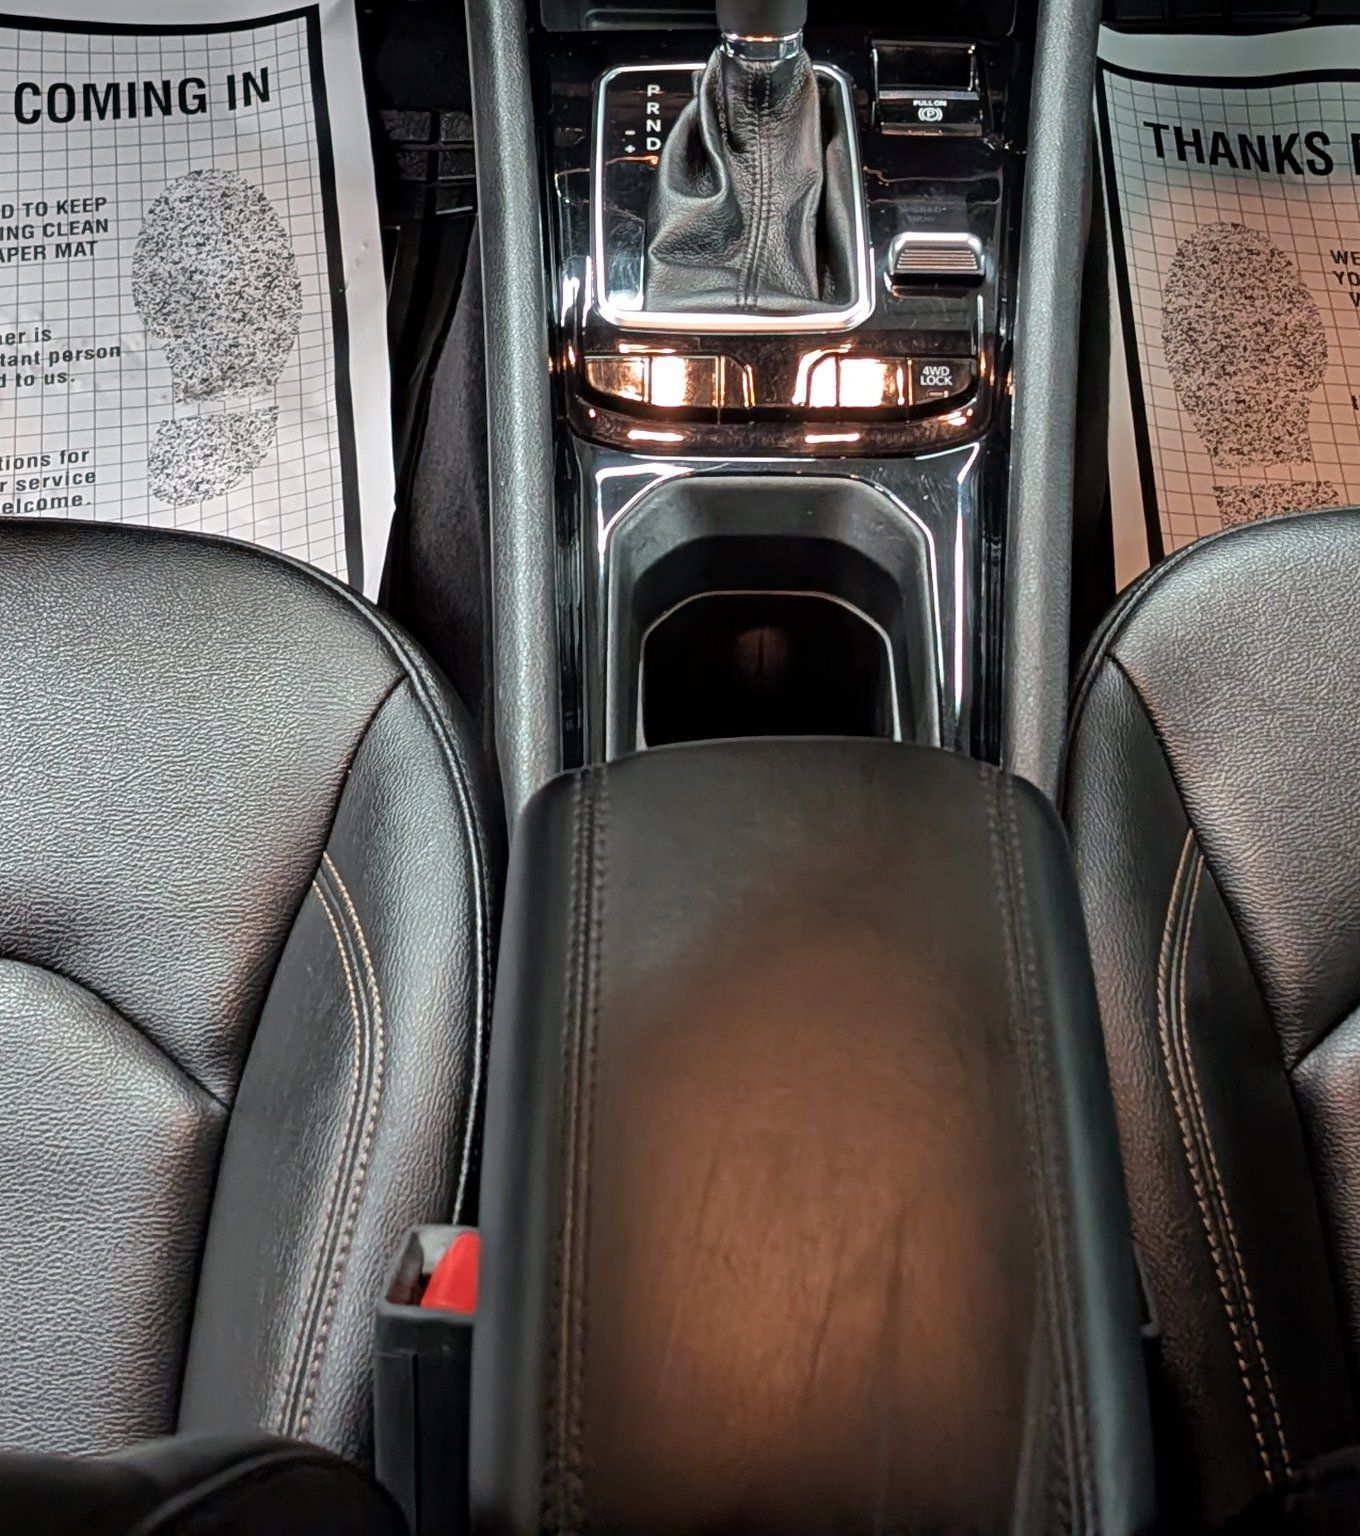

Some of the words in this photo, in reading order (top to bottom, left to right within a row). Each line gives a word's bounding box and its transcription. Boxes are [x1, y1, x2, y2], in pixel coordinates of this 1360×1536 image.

[13, 76, 207, 125] COMING
[227, 66, 272, 111] IN
[646, 84, 661, 97] P
[646, 101, 660, 115] R
[646, 119, 661, 132] N
[646, 137, 661, 151] D
[1143, 120, 1334, 177] THANKS
[22, 201, 49, 219] TO
[56, 196, 108, 215] KEEP
[42, 218, 110, 238] CLEAN
[55, 240, 99, 259] MAT
[34, 327, 53, 343] is
[48, 345, 122, 367] person
[922, 365, 950, 376] 4WD
[15, 374, 36, 388] to
[44, 371, 76, 386] us.
[920, 375, 953, 386] LOCK
[59, 449, 90, 465] for
[15, 471, 97, 492] service
